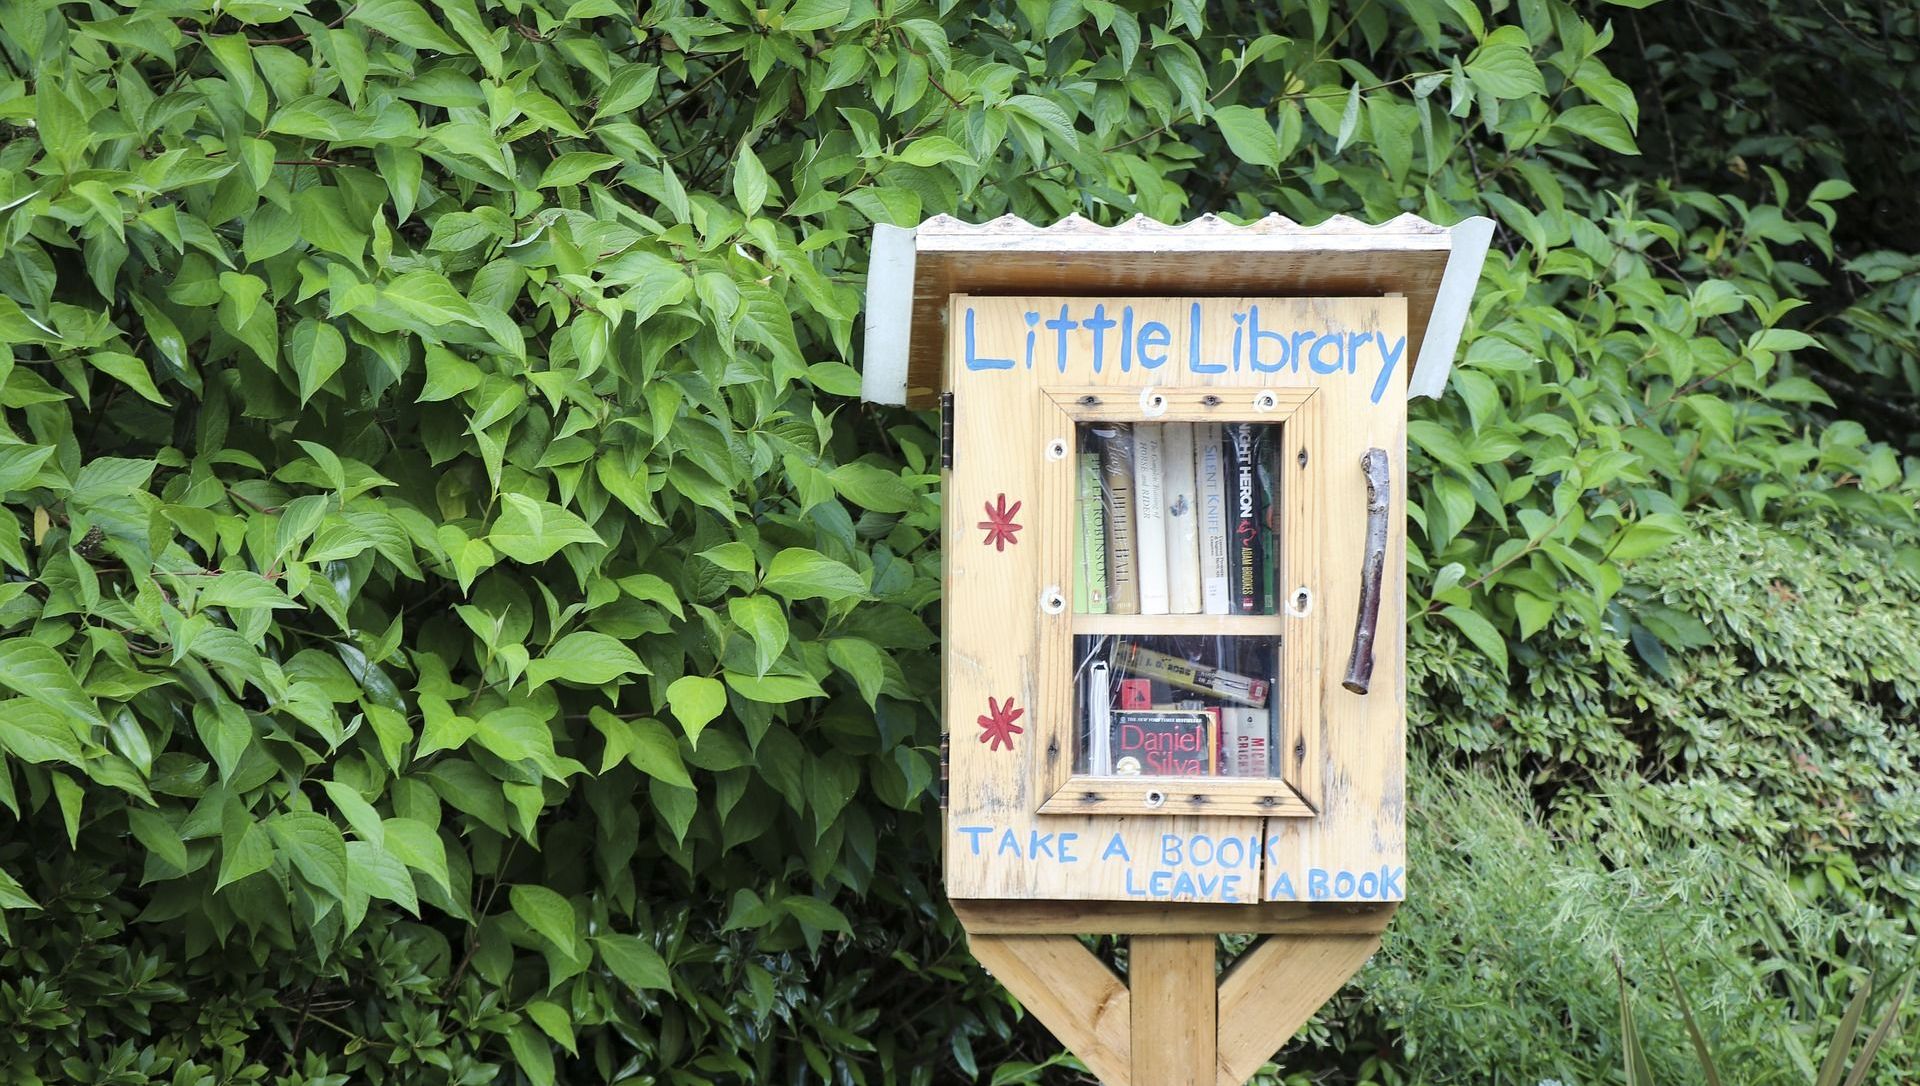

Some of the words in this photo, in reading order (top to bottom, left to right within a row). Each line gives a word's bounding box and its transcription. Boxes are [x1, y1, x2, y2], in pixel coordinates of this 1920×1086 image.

[964, 303, 1172, 374] Little
[1190, 302, 1406, 405] Library
[1139, 442, 1150, 471] HORSE
[1238, 423, 1251, 464] NIGHT
[1205, 445, 1217, 490] SILENT
[1142, 488, 1152, 519] RIDER
[1239, 466, 1253, 518] HERON
[1112, 487, 1128, 545] LUCILLE
[1206, 494, 1220, 534] KNIFE
[1093, 507, 1107, 583] ROBINSON
[1242, 547, 1253, 566] ADAM
[1115, 548, 1130, 586] BALL
[1242, 567, 1254, 595] BROOKES
[1121, 723, 1202, 753] Daniel
[1146, 751, 1201, 776] Silva
[958, 826, 1079, 863] TAKE
[1102, 833, 1130, 862] A
[1161, 834, 1280, 868] BOOK
[1126, 868, 1242, 904] LEAVE
[1271, 873, 1297, 899] A
[1308, 864, 1405, 900] BOOK
